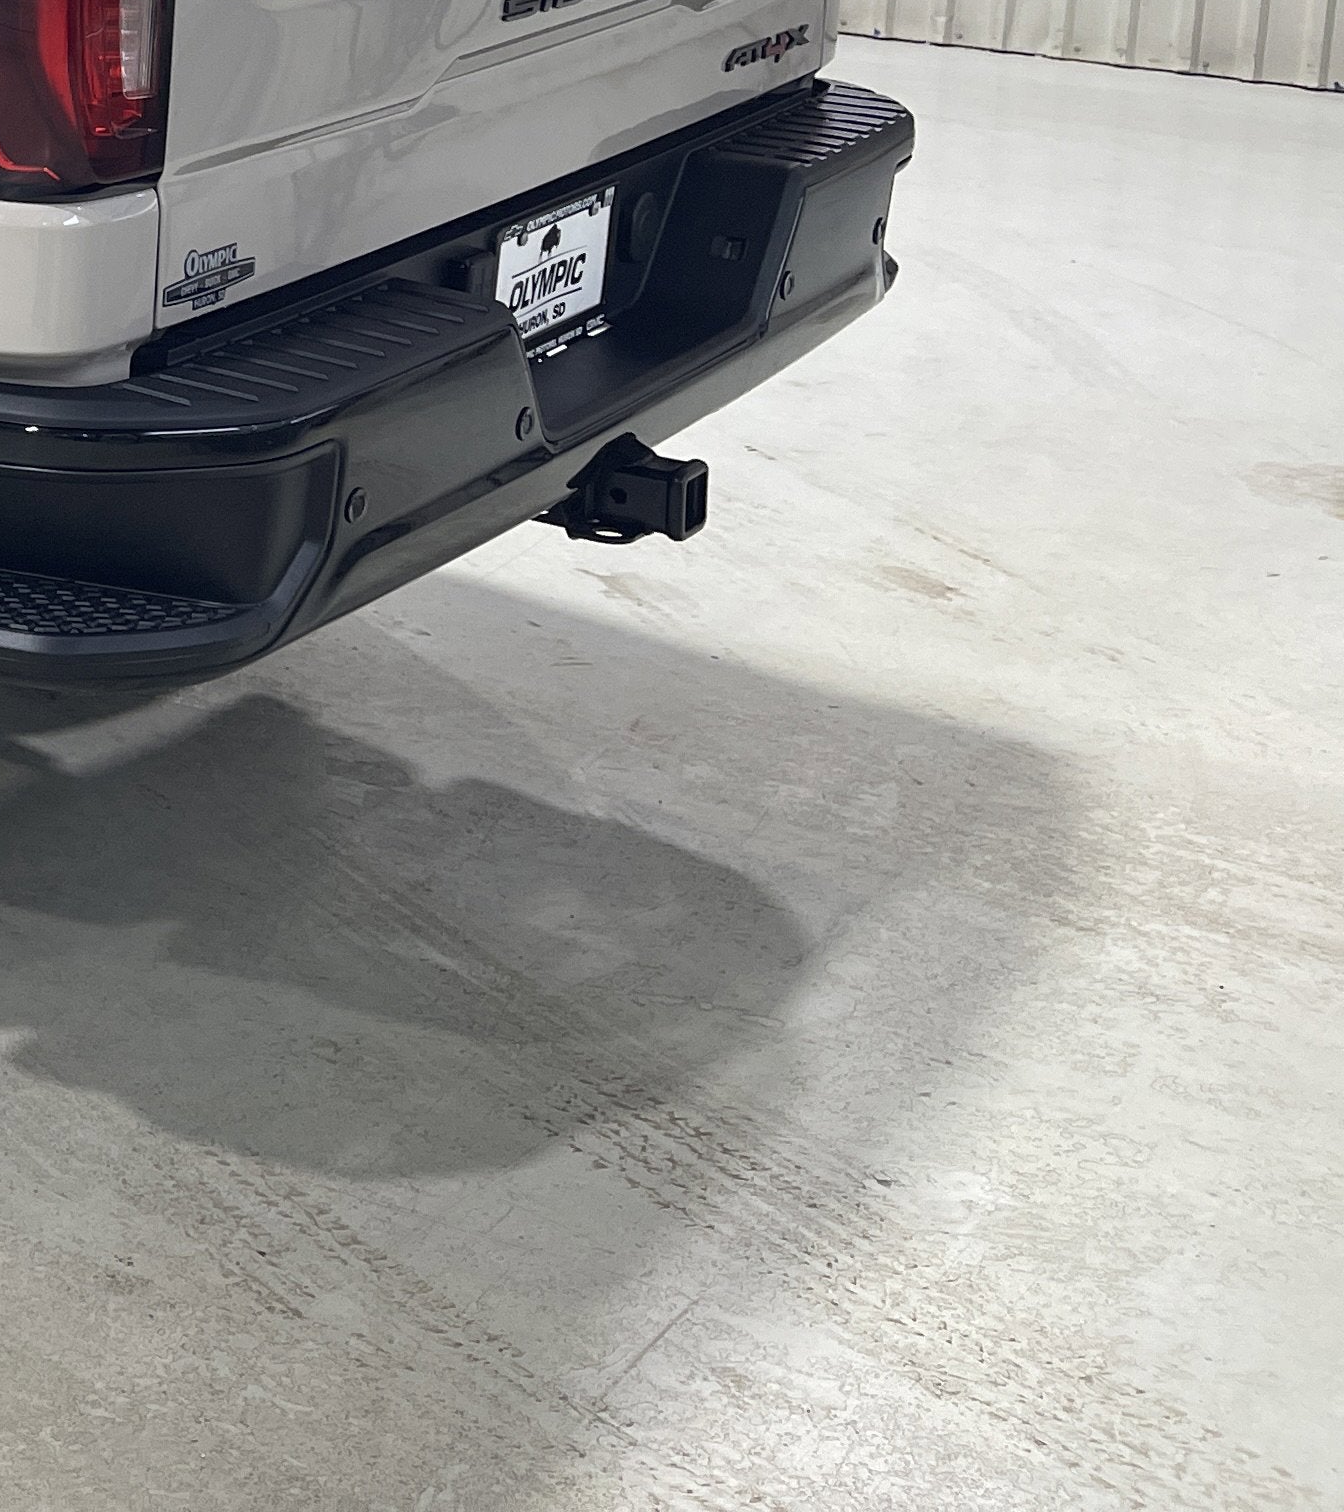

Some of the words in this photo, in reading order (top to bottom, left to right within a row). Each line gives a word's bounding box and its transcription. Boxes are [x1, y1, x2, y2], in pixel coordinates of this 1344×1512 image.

[721, 24, 810, 72] AT4X
[185, 245, 238, 277] OLYMPIC
[509, 253, 586, 313] OLYMPIC
[552, 302, 566, 320] SD
